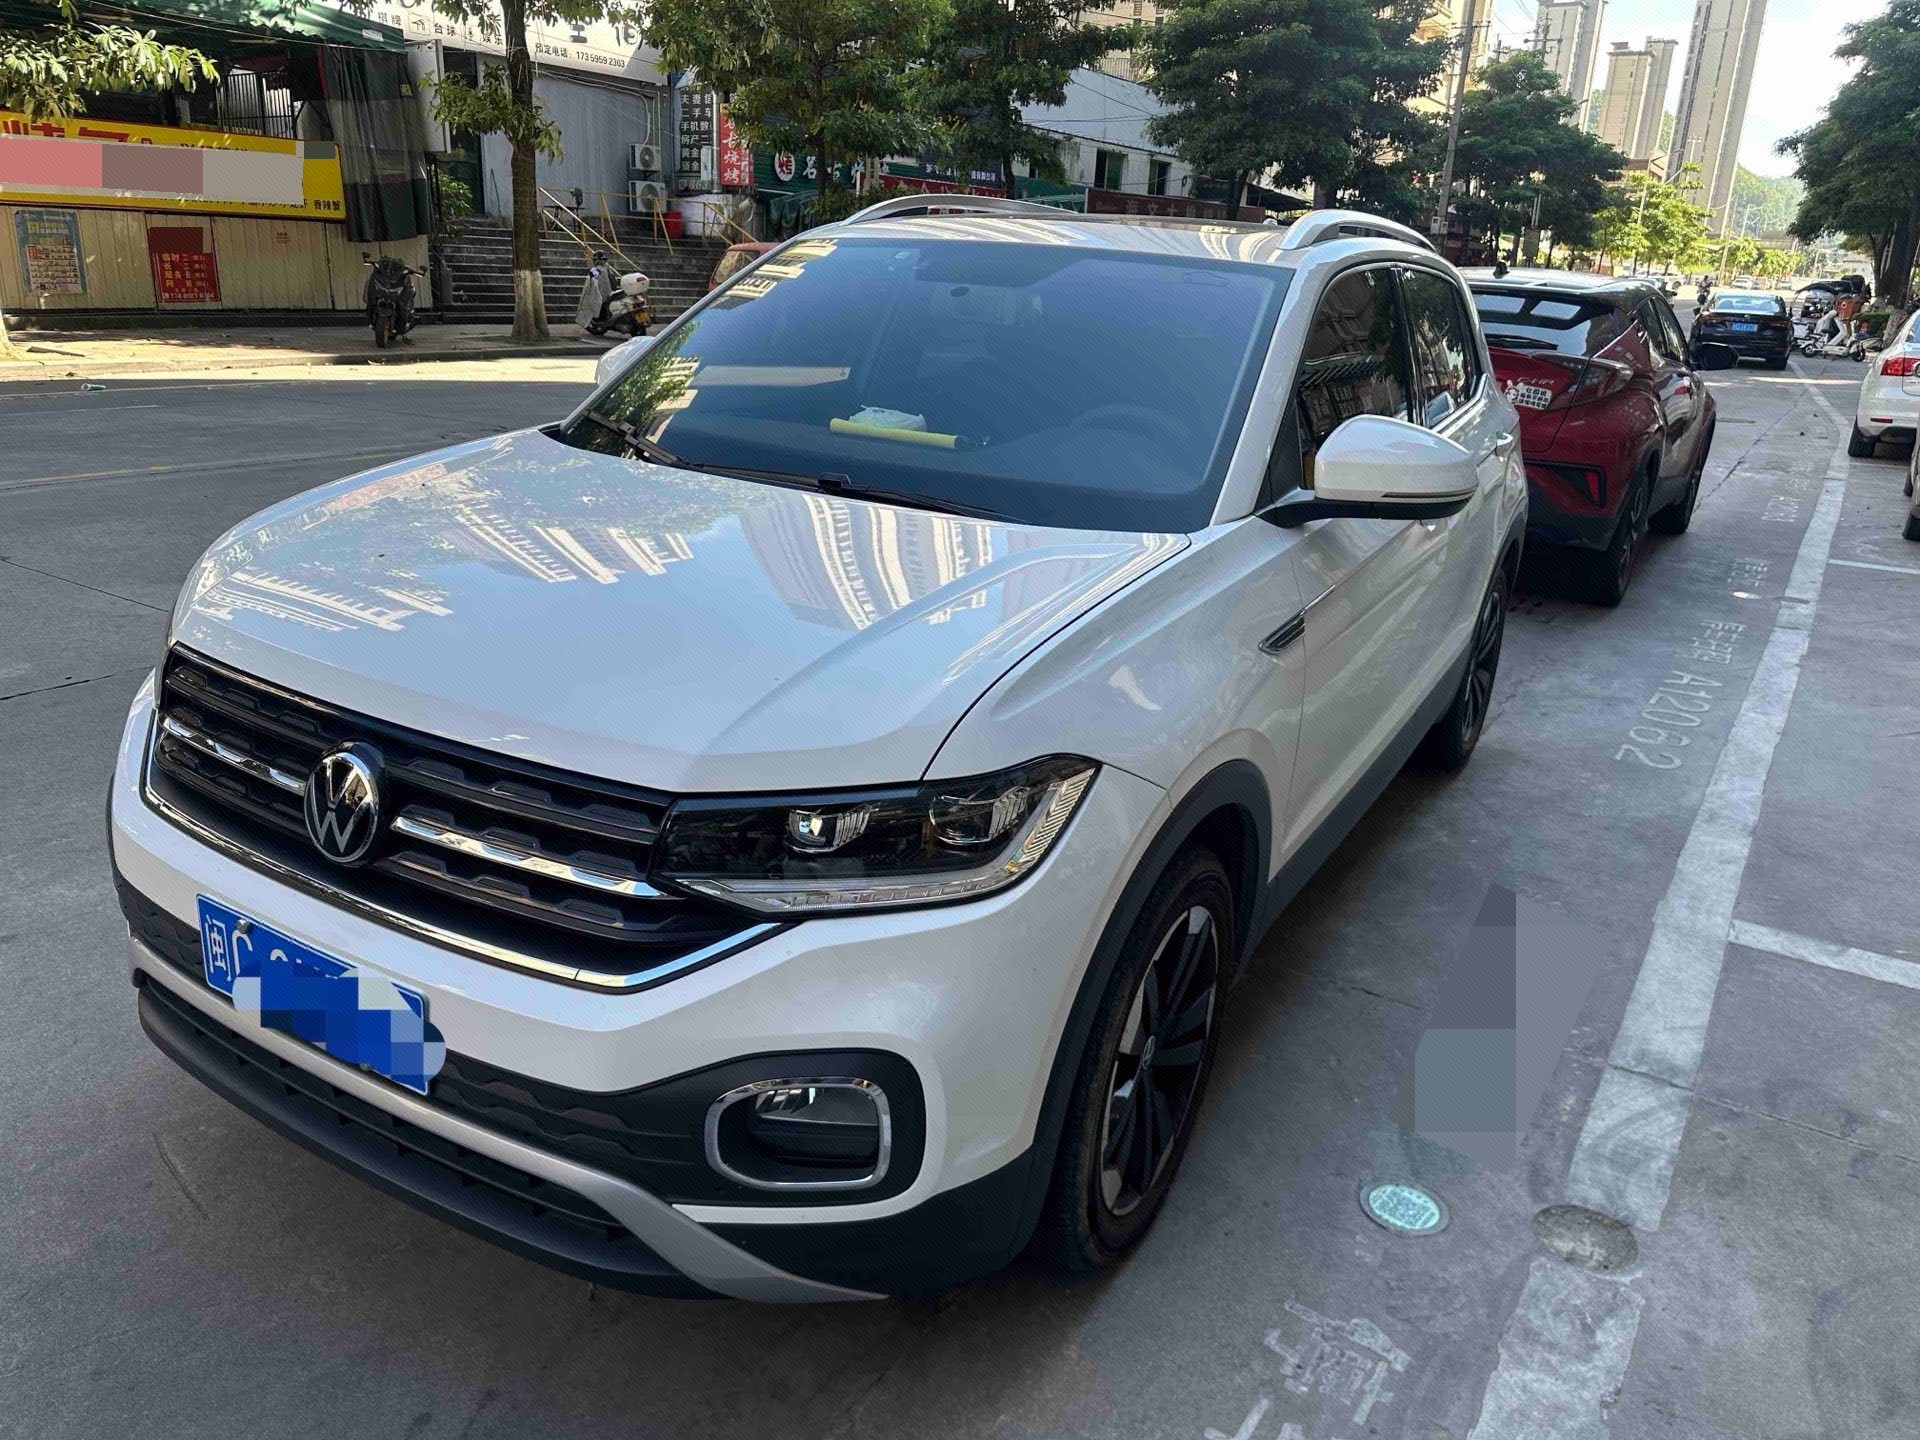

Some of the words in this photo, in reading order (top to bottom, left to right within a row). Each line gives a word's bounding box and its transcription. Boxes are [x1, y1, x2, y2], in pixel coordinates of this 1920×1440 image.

[576, 51, 590, 62] 173
[590, 54, 608, 65] 5959
[608, 57, 626, 69] 2303
[1615, 670, 1724, 770] A12062
